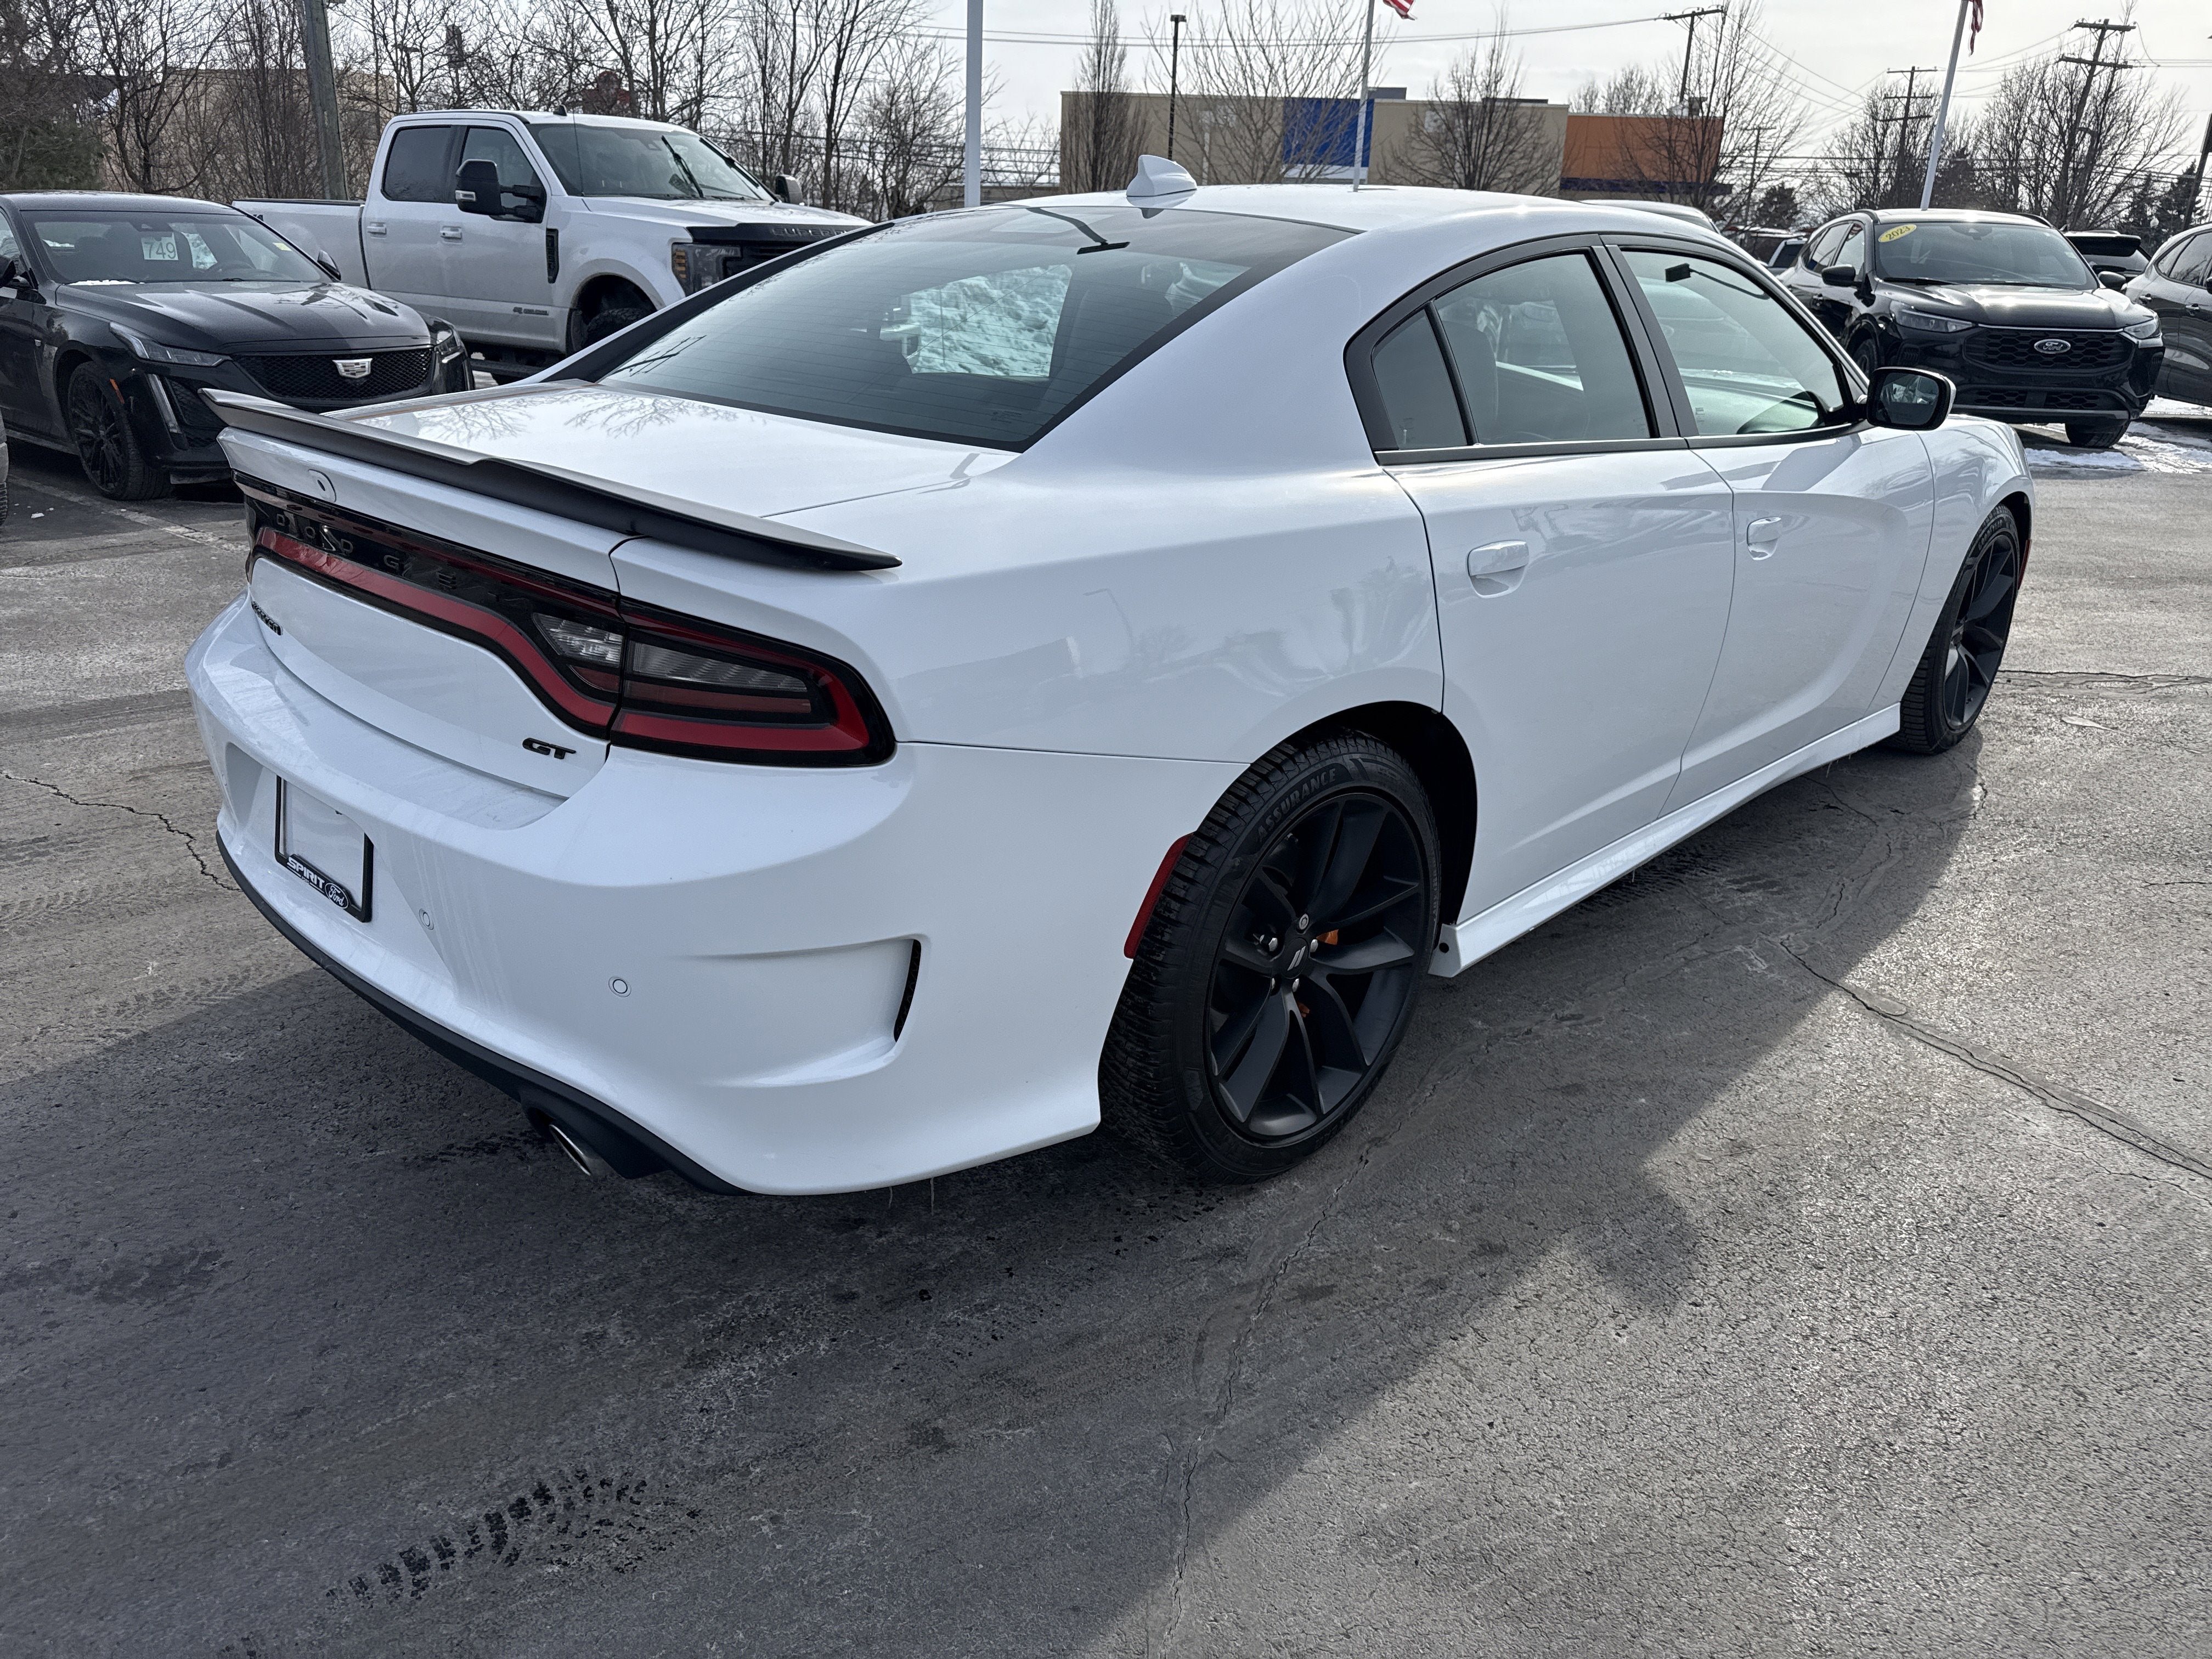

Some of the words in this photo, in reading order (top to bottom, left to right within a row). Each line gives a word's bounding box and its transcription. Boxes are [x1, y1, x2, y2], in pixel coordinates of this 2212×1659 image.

[1886, 226, 1910, 240] 2023
[144, 242, 176, 259] 749
[522, 737, 577, 760] GT
[1257, 768, 1336, 840] ASSURANCE
[286, 856, 325, 889] SPIRIT
[328, 885, 345, 906] Ford
